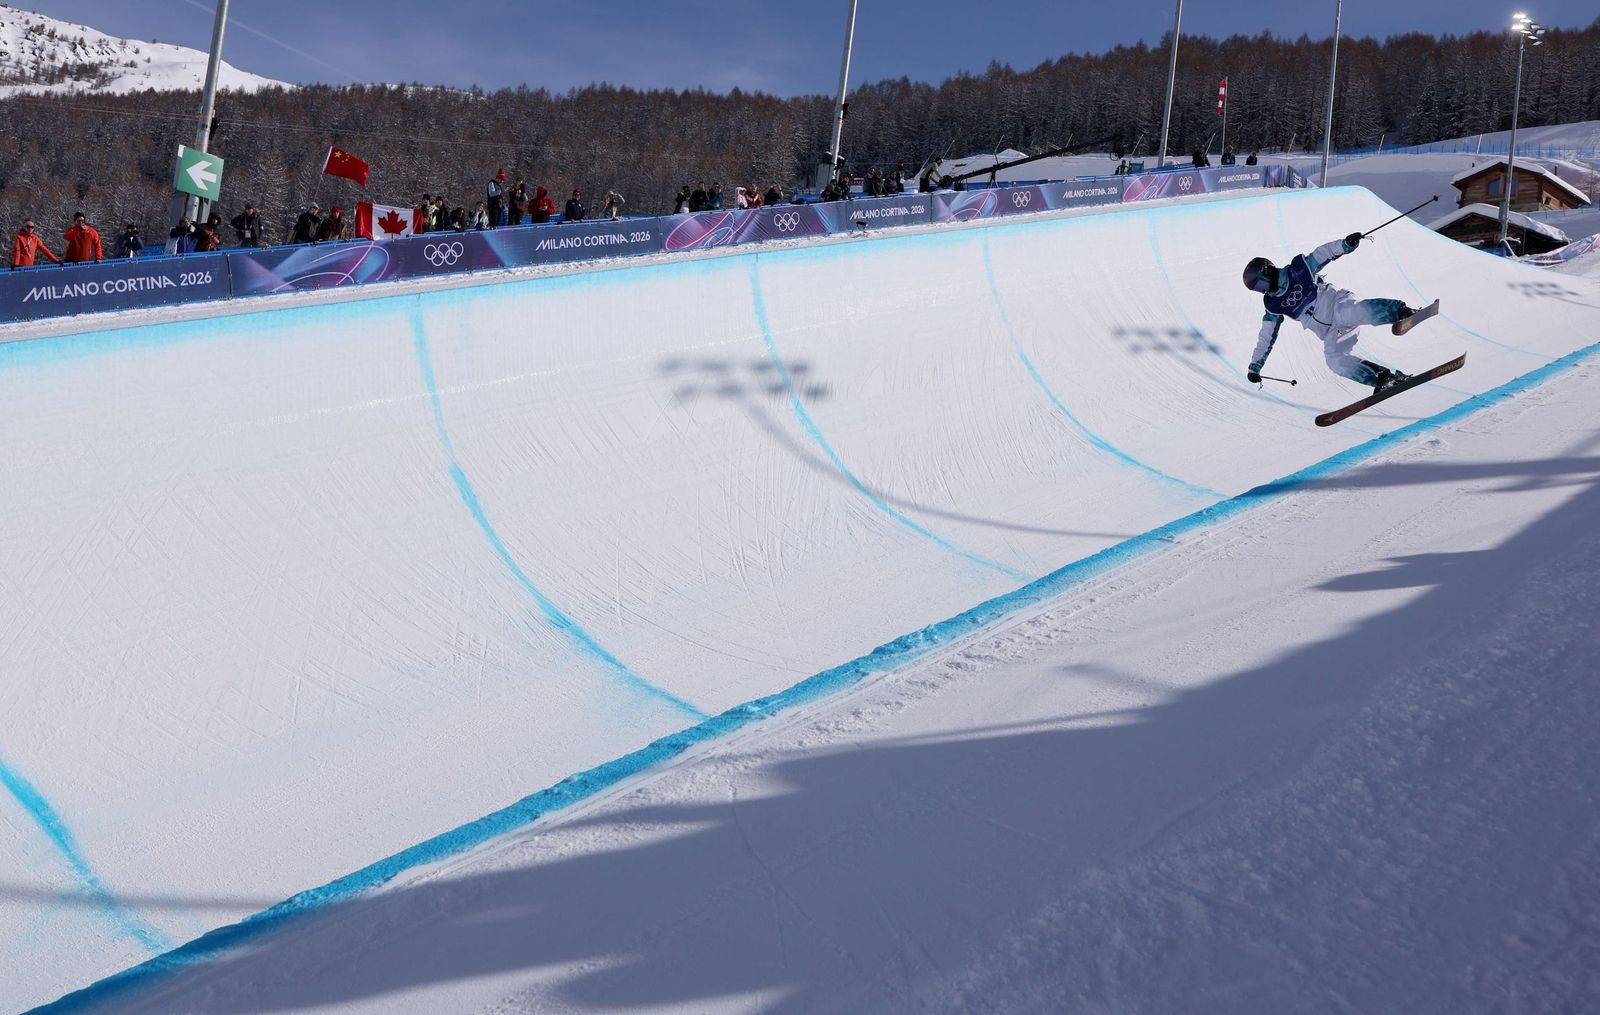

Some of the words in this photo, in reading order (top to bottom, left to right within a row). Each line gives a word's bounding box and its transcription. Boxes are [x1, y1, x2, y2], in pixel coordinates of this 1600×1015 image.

[1063, 190, 1084, 199] MILANO
[850, 209, 880, 220] MILANO
[881, 207, 909, 217] CORTINA
[911, 205, 925, 214] 2026
[535, 237, 582, 251] MILANO
[583, 233, 629, 247] CORTINA
[630, 231, 651, 243] 2026
[22, 281, 100, 302] MILANO
[102, 275, 177, 294] CORTINA
[179, 271, 213, 286] 2026
